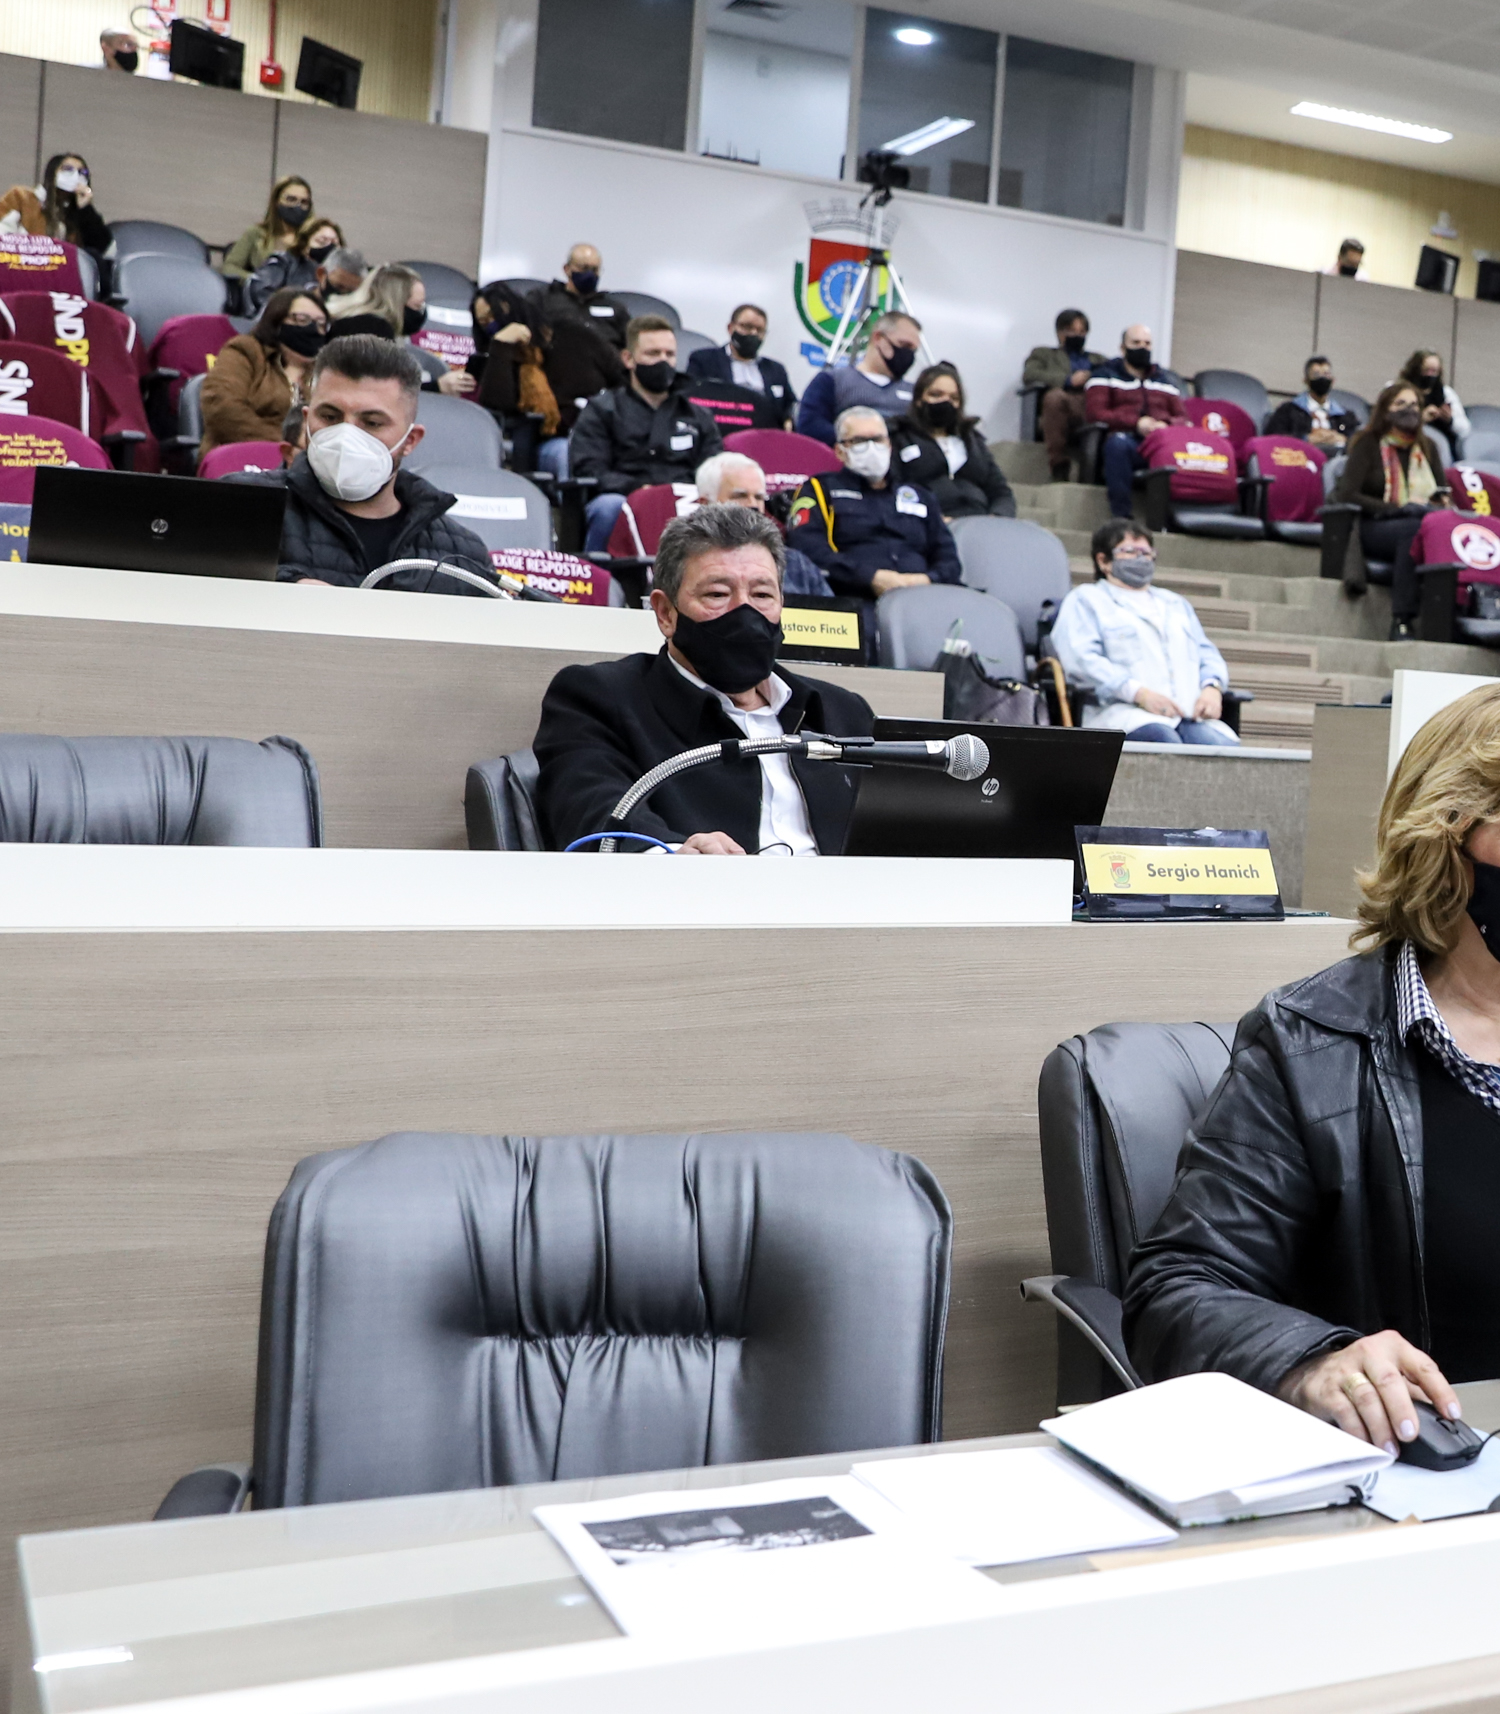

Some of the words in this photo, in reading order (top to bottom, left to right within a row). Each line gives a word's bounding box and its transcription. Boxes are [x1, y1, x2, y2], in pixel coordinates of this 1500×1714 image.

[492, 553, 524, 571] EXIGE
[526, 558, 592, 579] RESPOSTAS
[781, 622, 817, 633] ustavo
[820, 623, 848, 635] Finck
[1146, 862, 1200, 882] Sergio
[1205, 864, 1260, 879] Hanich
